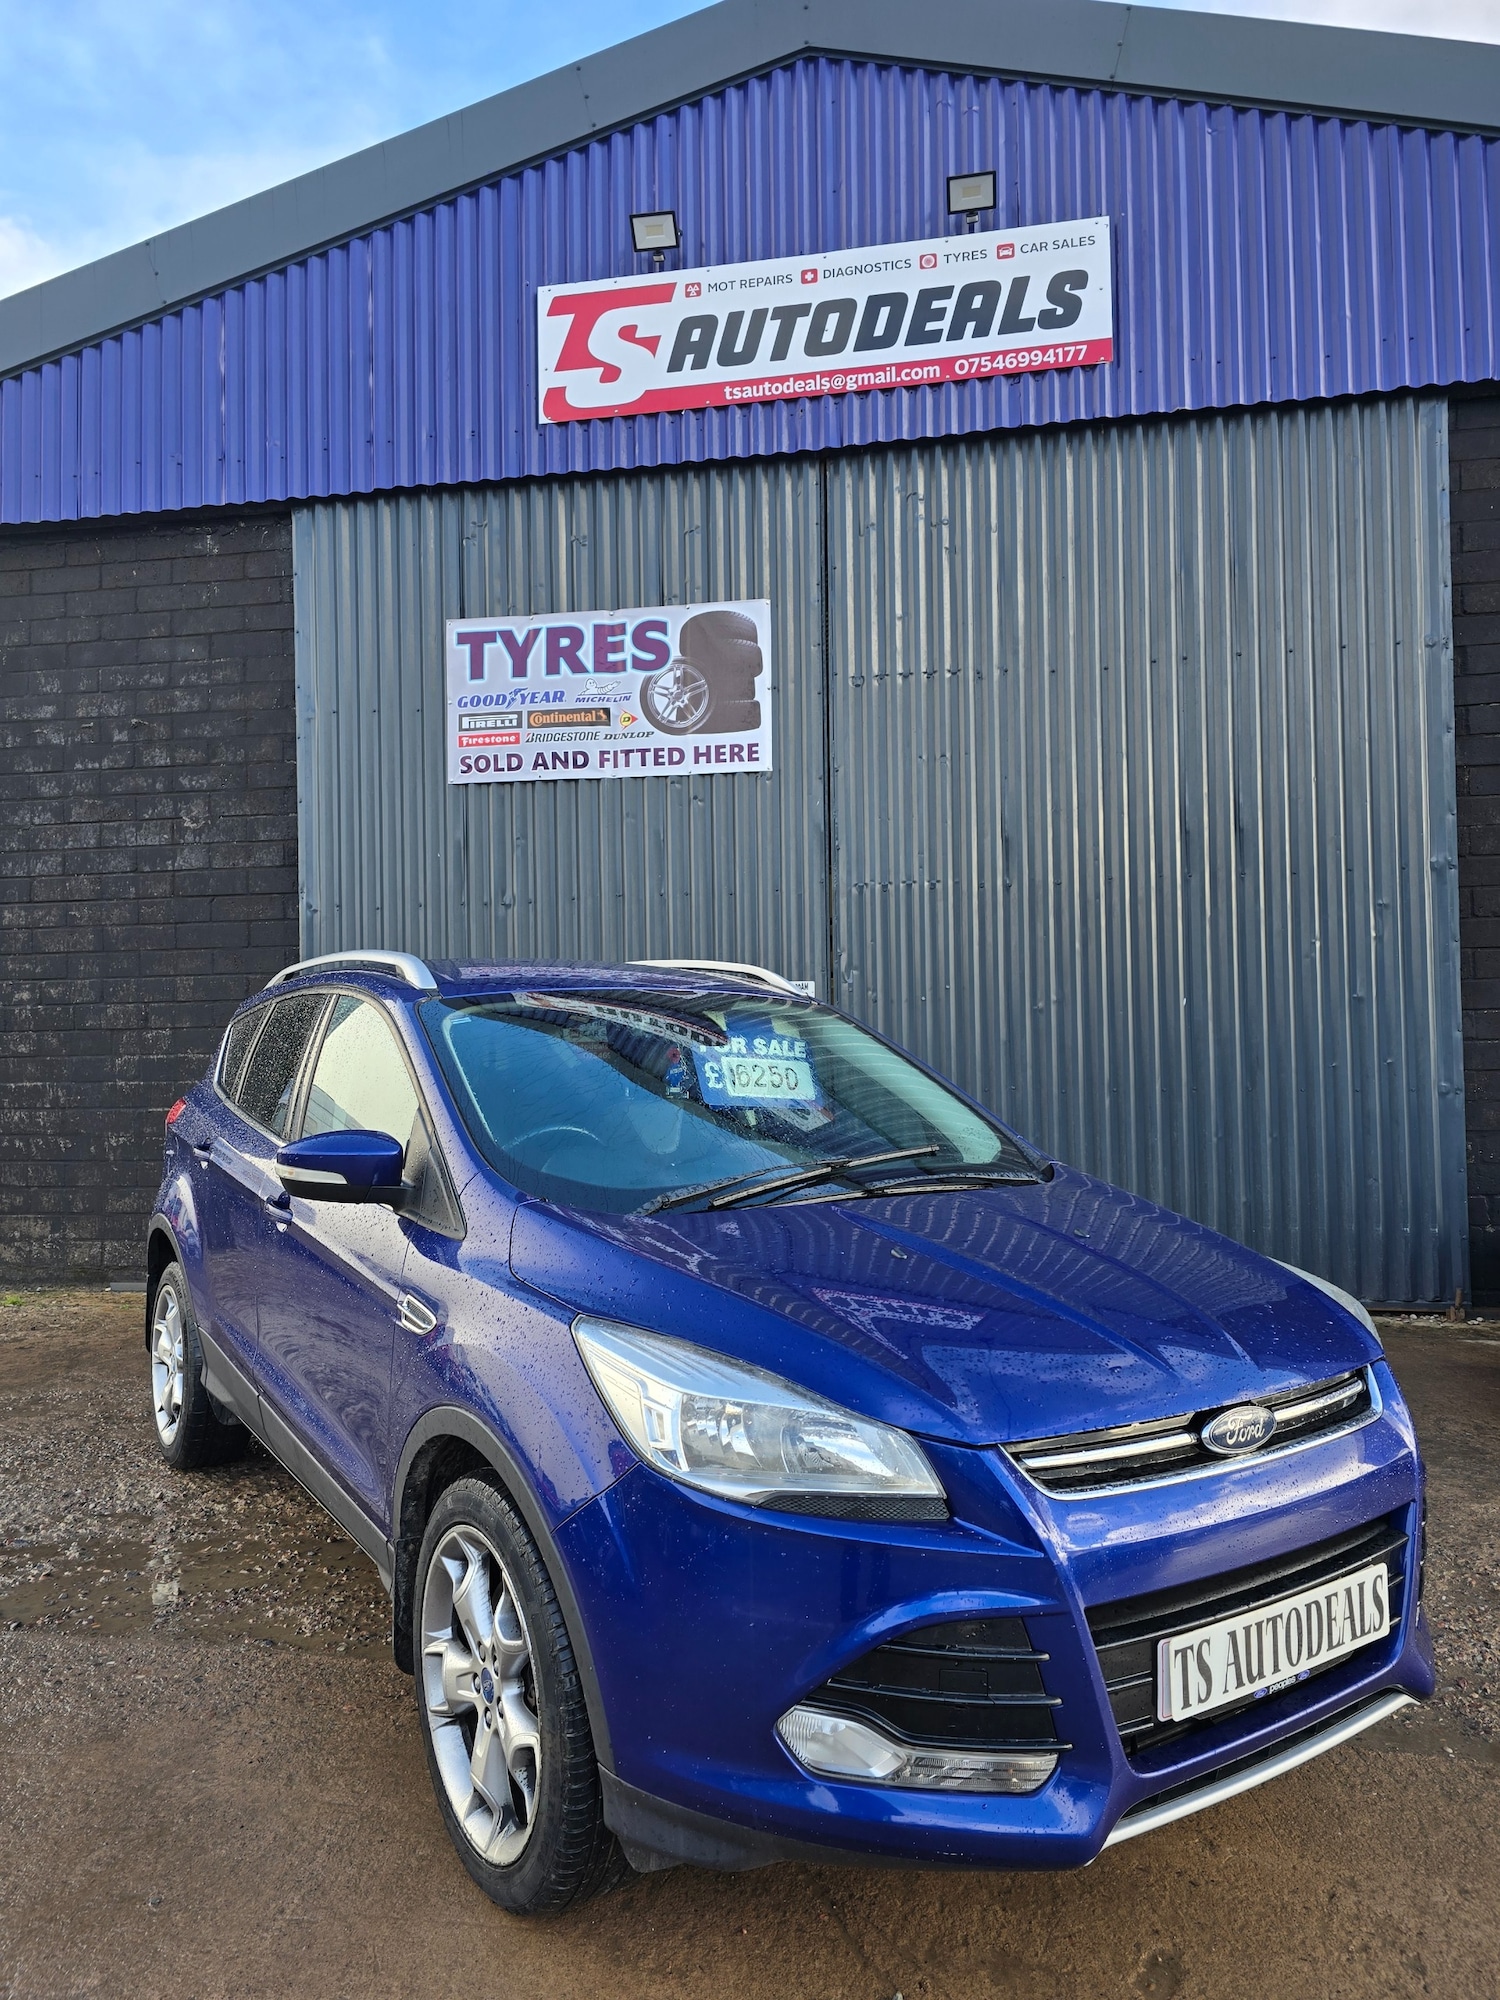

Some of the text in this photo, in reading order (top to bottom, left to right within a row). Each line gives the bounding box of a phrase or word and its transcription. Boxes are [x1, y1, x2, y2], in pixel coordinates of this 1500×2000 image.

[1020, 235, 1096, 254] CAR SALES
[943, 249, 988, 264] TYRES
[823, 258, 912, 279] DIAGNOSTICS
[707, 273, 793, 293] MOT REPAIRS
[545, 269, 1089, 410] TS AUTODEALS
[724, 344, 1088, 401] tsautodeals@gmail.com 07546994177
[457, 619, 671, 681] TYRES
[457, 688, 566, 709] GOODYEAR
[575, 694, 632, 703] MICHELIN
[462, 713, 518, 729] PIRELLI
[529, 710, 596, 727] Continental
[462, 734, 517, 747] Firestone
[525, 731, 601, 743] BRIDGESTONE
[603, 731, 655, 741] DUNLOP
[460, 742, 760, 774] SOLD AND FITTED HERE
[753, 1037, 807, 1059] SALE
[1226, 1413, 1265, 1445] Ford
[1174, 1574, 1385, 1711] TS AUTODEALS
